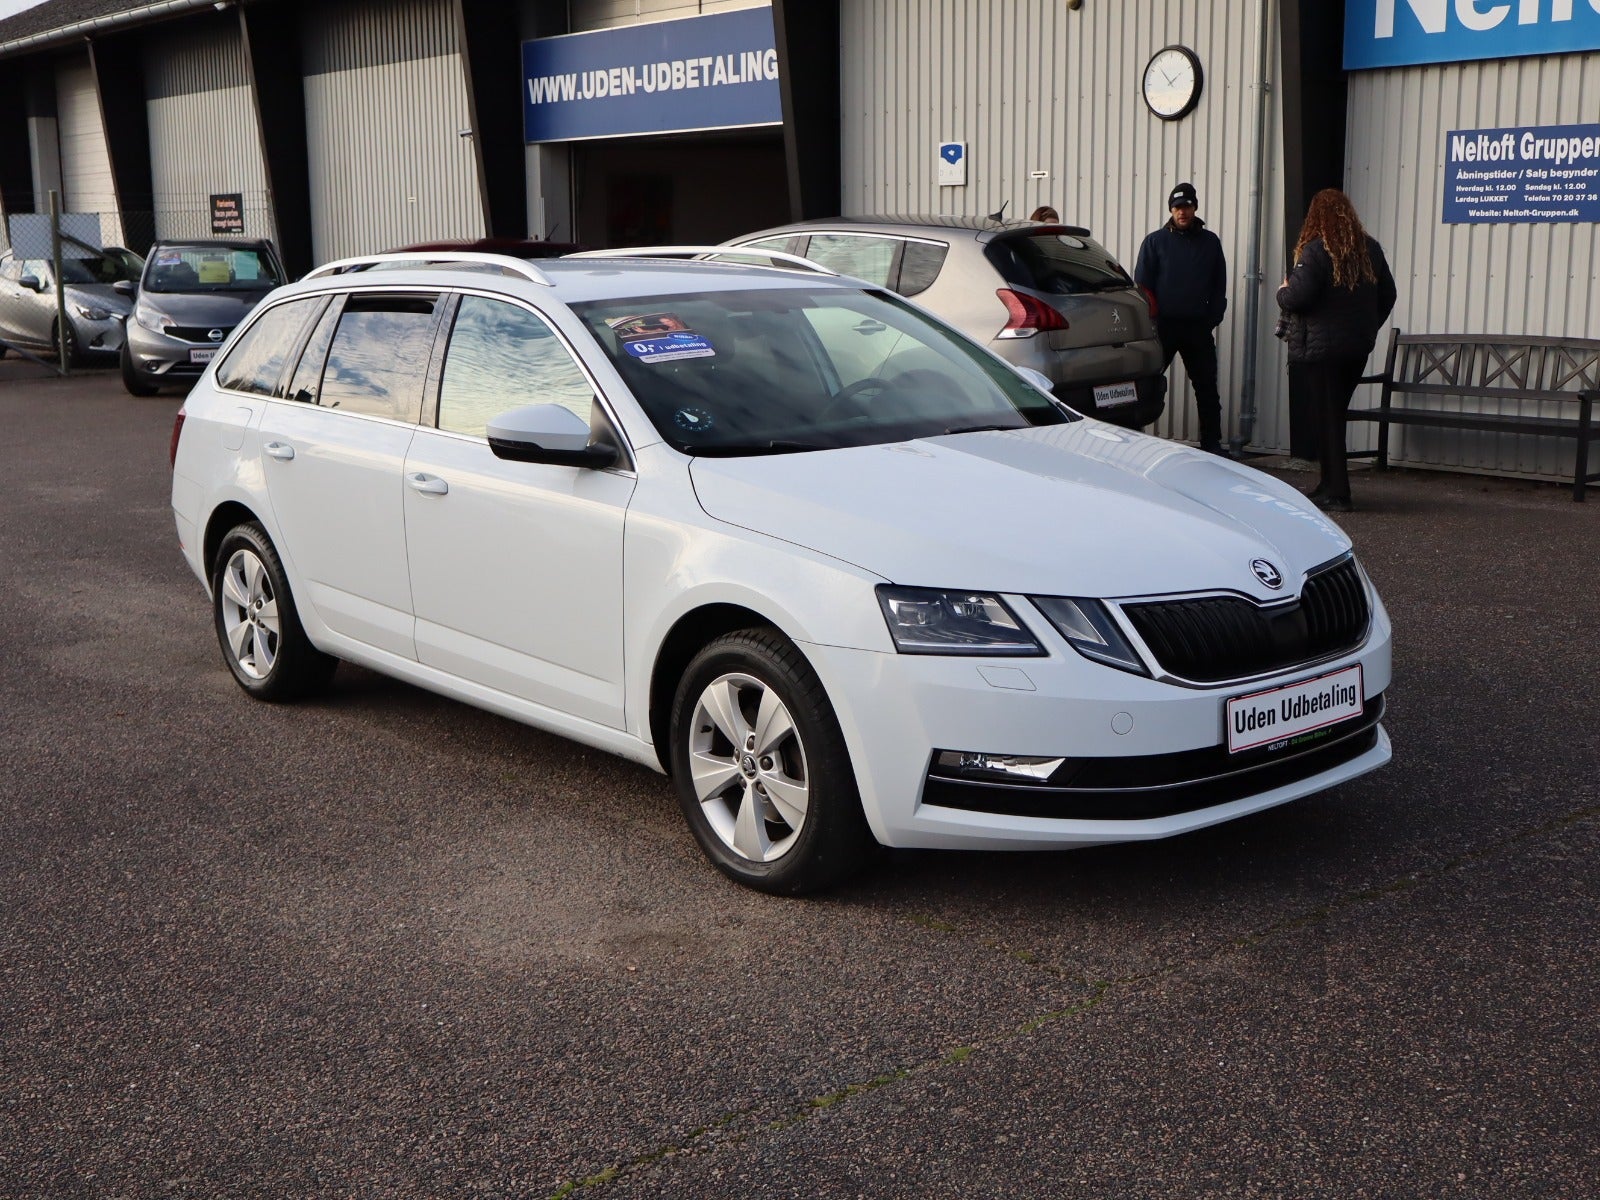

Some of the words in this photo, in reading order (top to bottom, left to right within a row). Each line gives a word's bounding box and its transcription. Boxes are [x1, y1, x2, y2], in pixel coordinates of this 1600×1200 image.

[528, 49, 779, 104] WWW.UDEN-UDBETALING
[1451, 133, 1515, 162] Neltoft
[1456, 168, 1517, 180] Åbningstider
[1526, 168, 1548, 179] Salg
[1550, 167, 1599, 179] begynder
[1469, 209, 1501, 217] Website:
[1503, 209, 1579, 218] Neltoft-Gruppen.dk
[665, 342, 707, 350] udbetaling
[1235, 707, 1276, 734] Uden
[1281, 683, 1356, 722] Udbetaling
